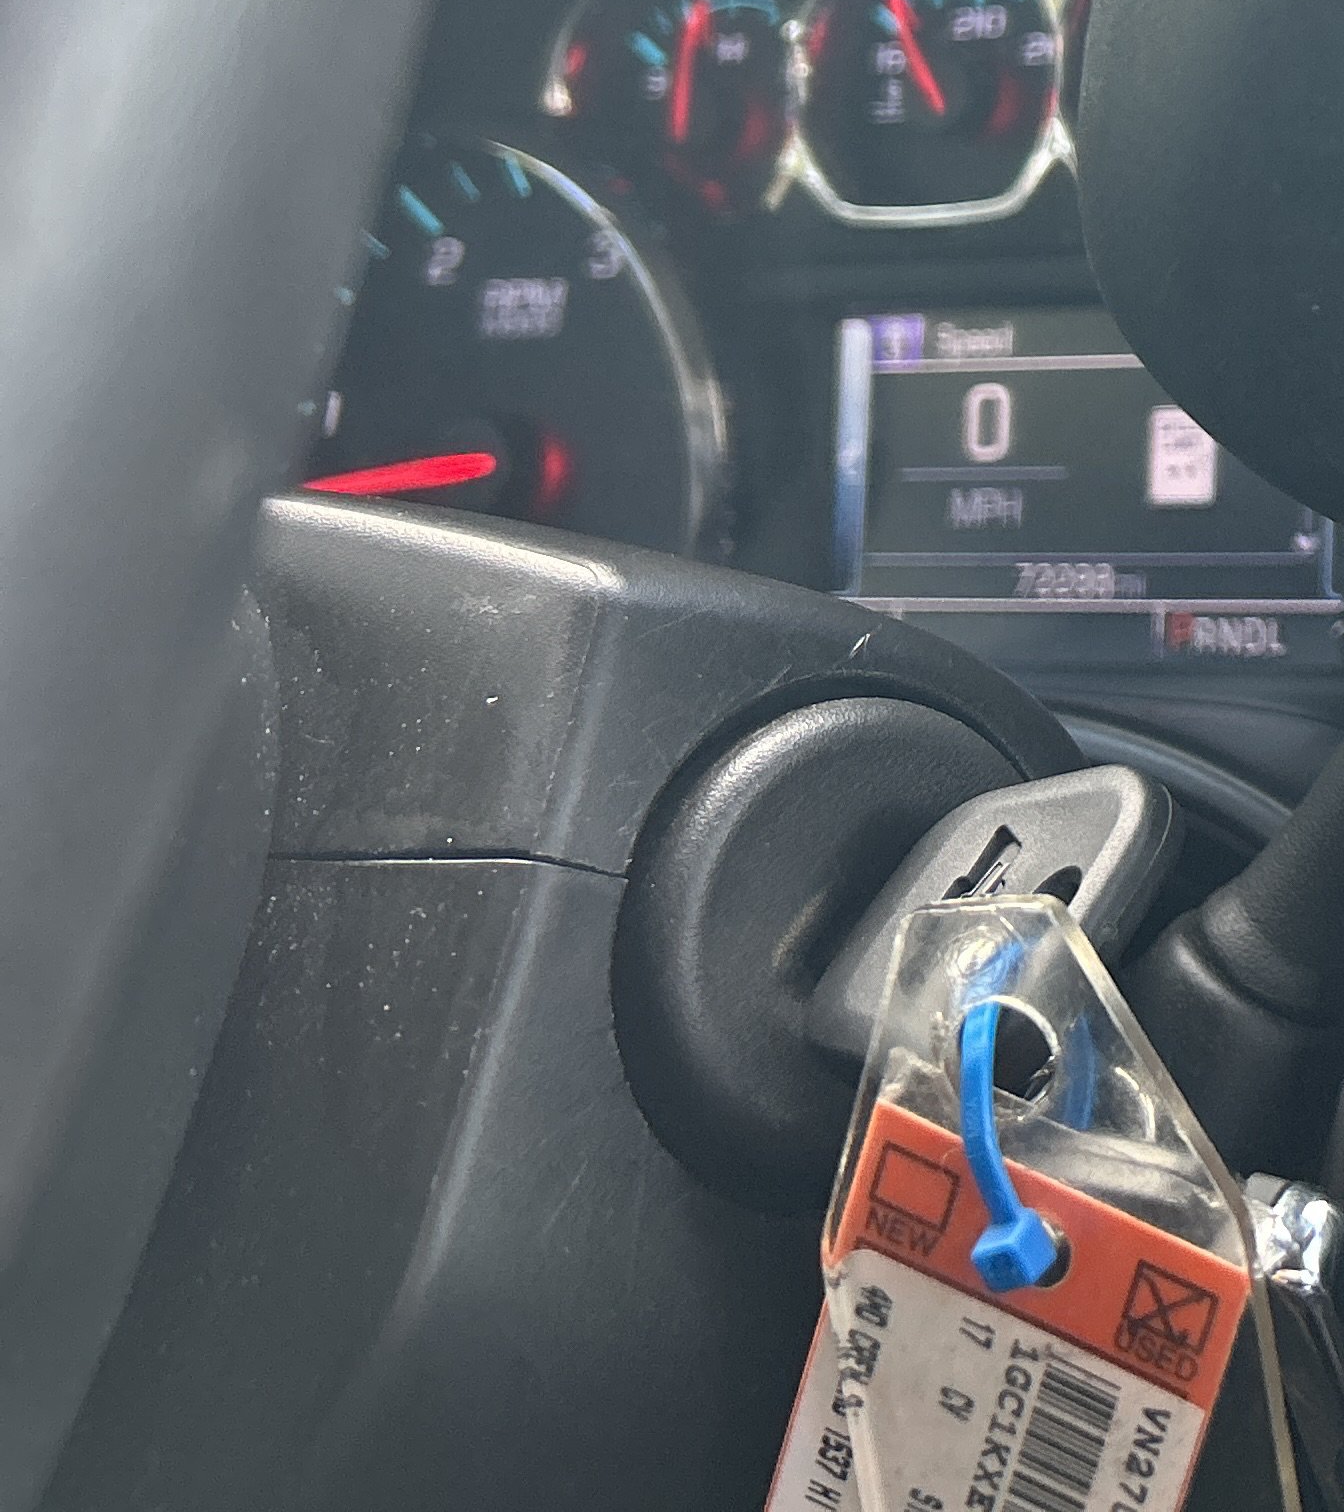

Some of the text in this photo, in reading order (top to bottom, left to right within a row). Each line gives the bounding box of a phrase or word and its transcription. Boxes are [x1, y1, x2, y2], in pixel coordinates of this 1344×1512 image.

[425, 236, 465, 286] 2
[964, 382, 1012, 463] 0
[948, 486, 1023, 529] MPH
[866, 1202, 940, 1257] NEW
[959, 1316, 996, 1350] 17
[1116, 1318, 1199, 1382] USED
